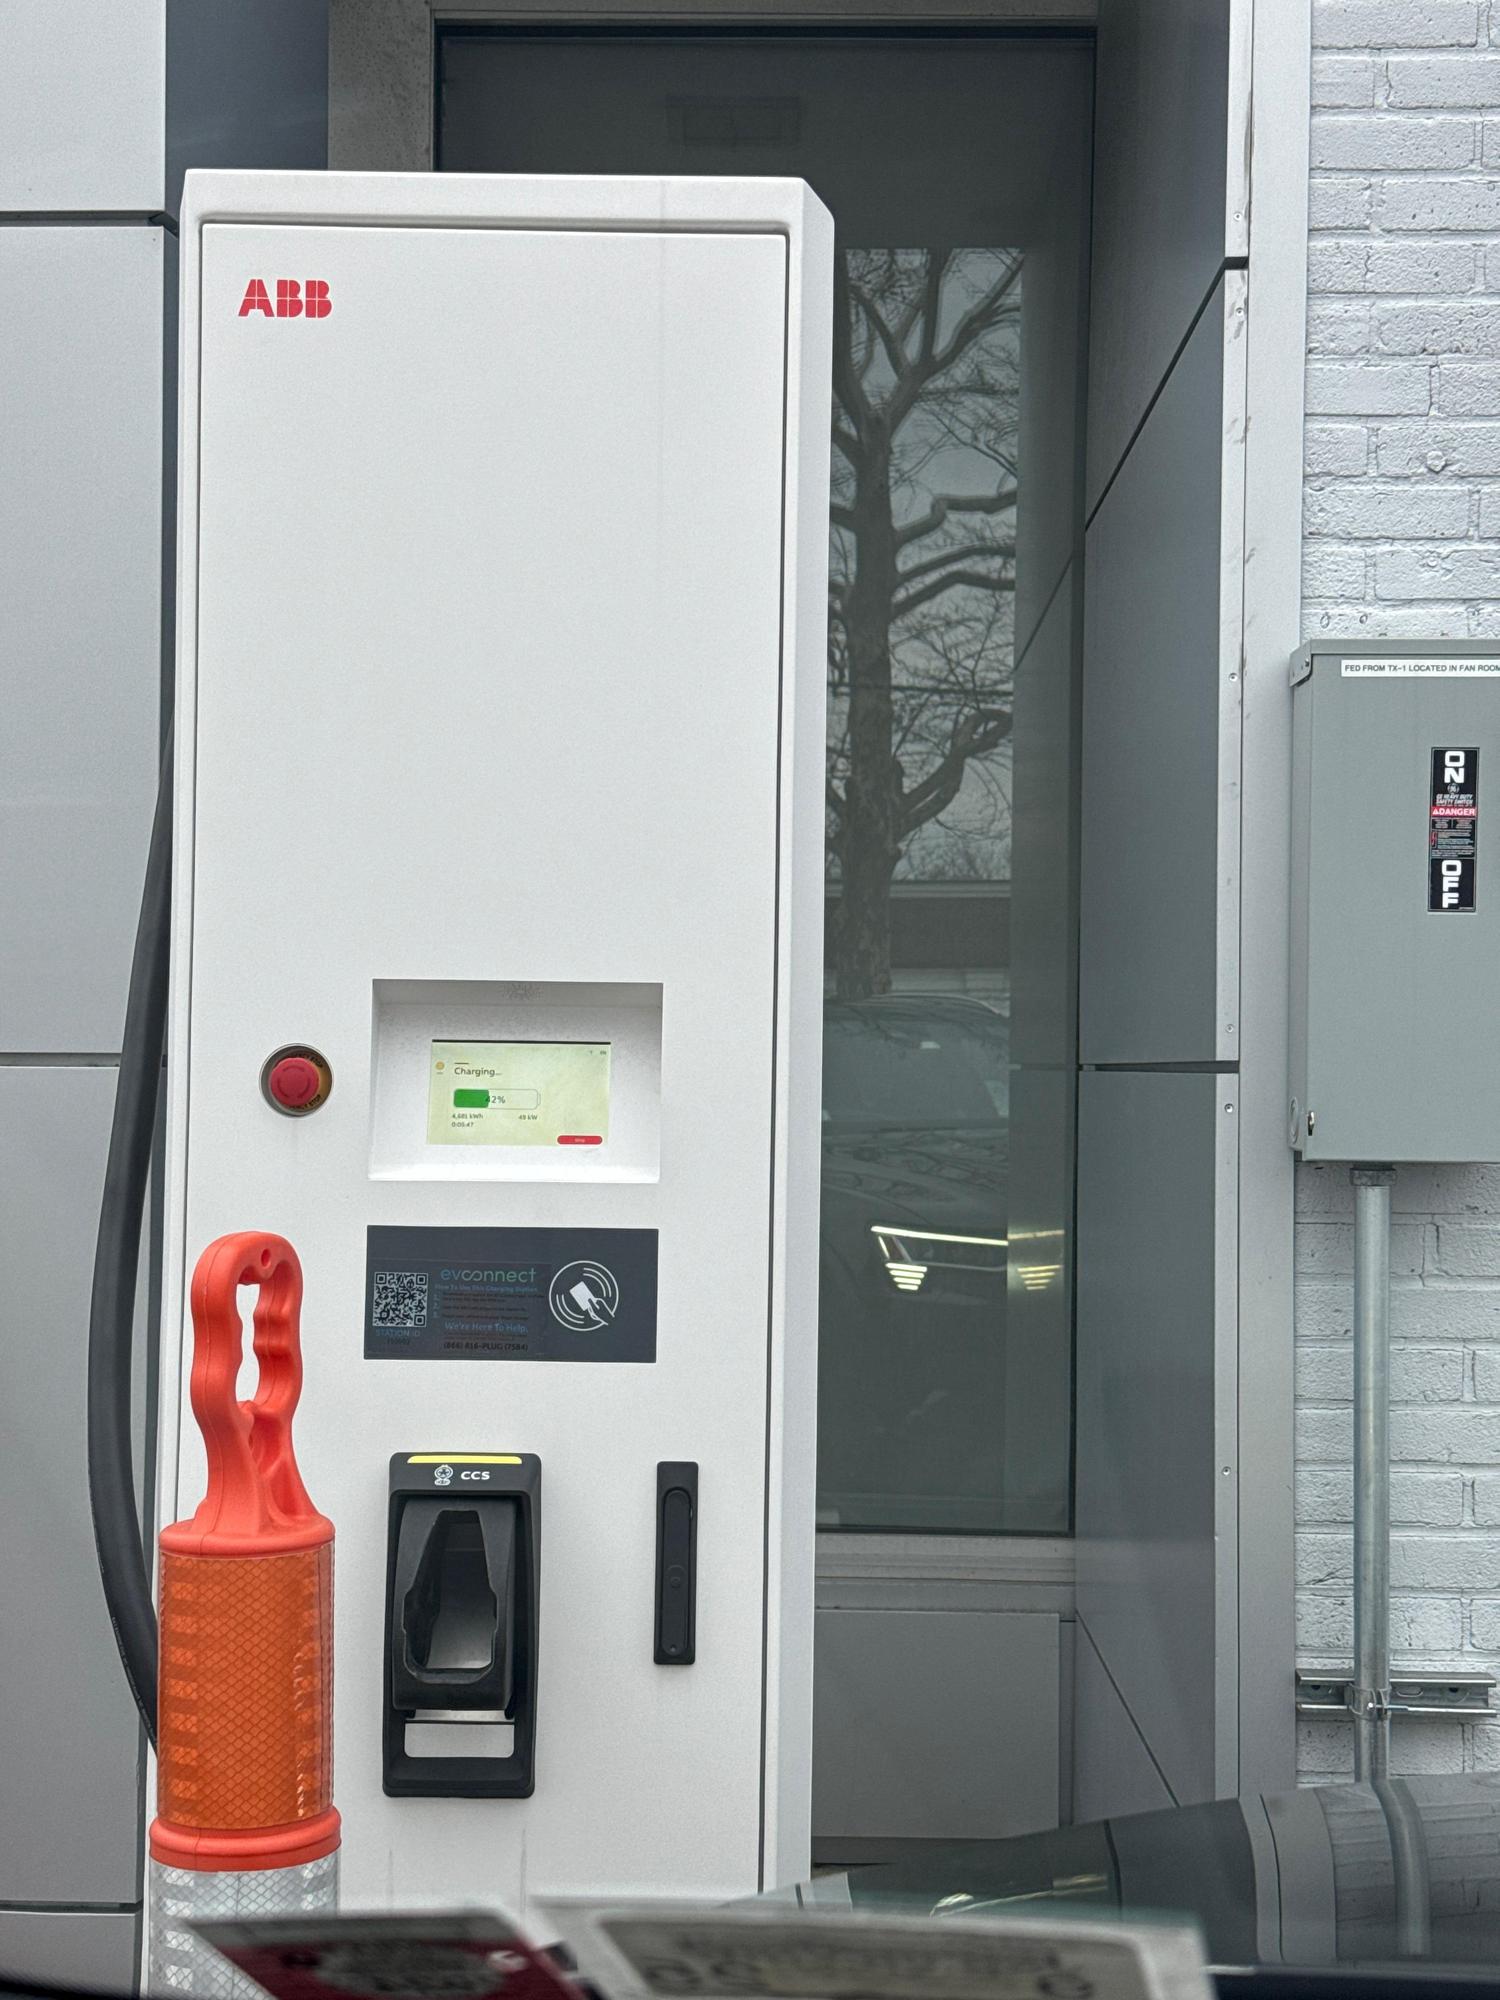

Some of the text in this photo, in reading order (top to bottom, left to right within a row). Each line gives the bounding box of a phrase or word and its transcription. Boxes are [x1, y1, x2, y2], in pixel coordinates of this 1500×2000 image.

[238, 279, 332, 318] ABB
[1344, 664, 1361, 672] FED
[1362, 664, 1386, 672] FROM
[1388, 664, 1406, 672] TX-1
[1408, 664, 1447, 672] LOCATED
[1449, 664, 1458, 672] IN
[1459, 664, 1476, 672] FAN
[1444, 750, 1465, 783] ON
[1442, 860, 1462, 908] OFF
[440, 1267, 536, 1283] evconnect
[375, 1328, 410, 1337] STATION
[445, 1321, 470, 1330] We're
[472, 1323, 493, 1331] Here
[494, 1323, 505, 1331] To
[460, 1471, 490, 1480] CCS
